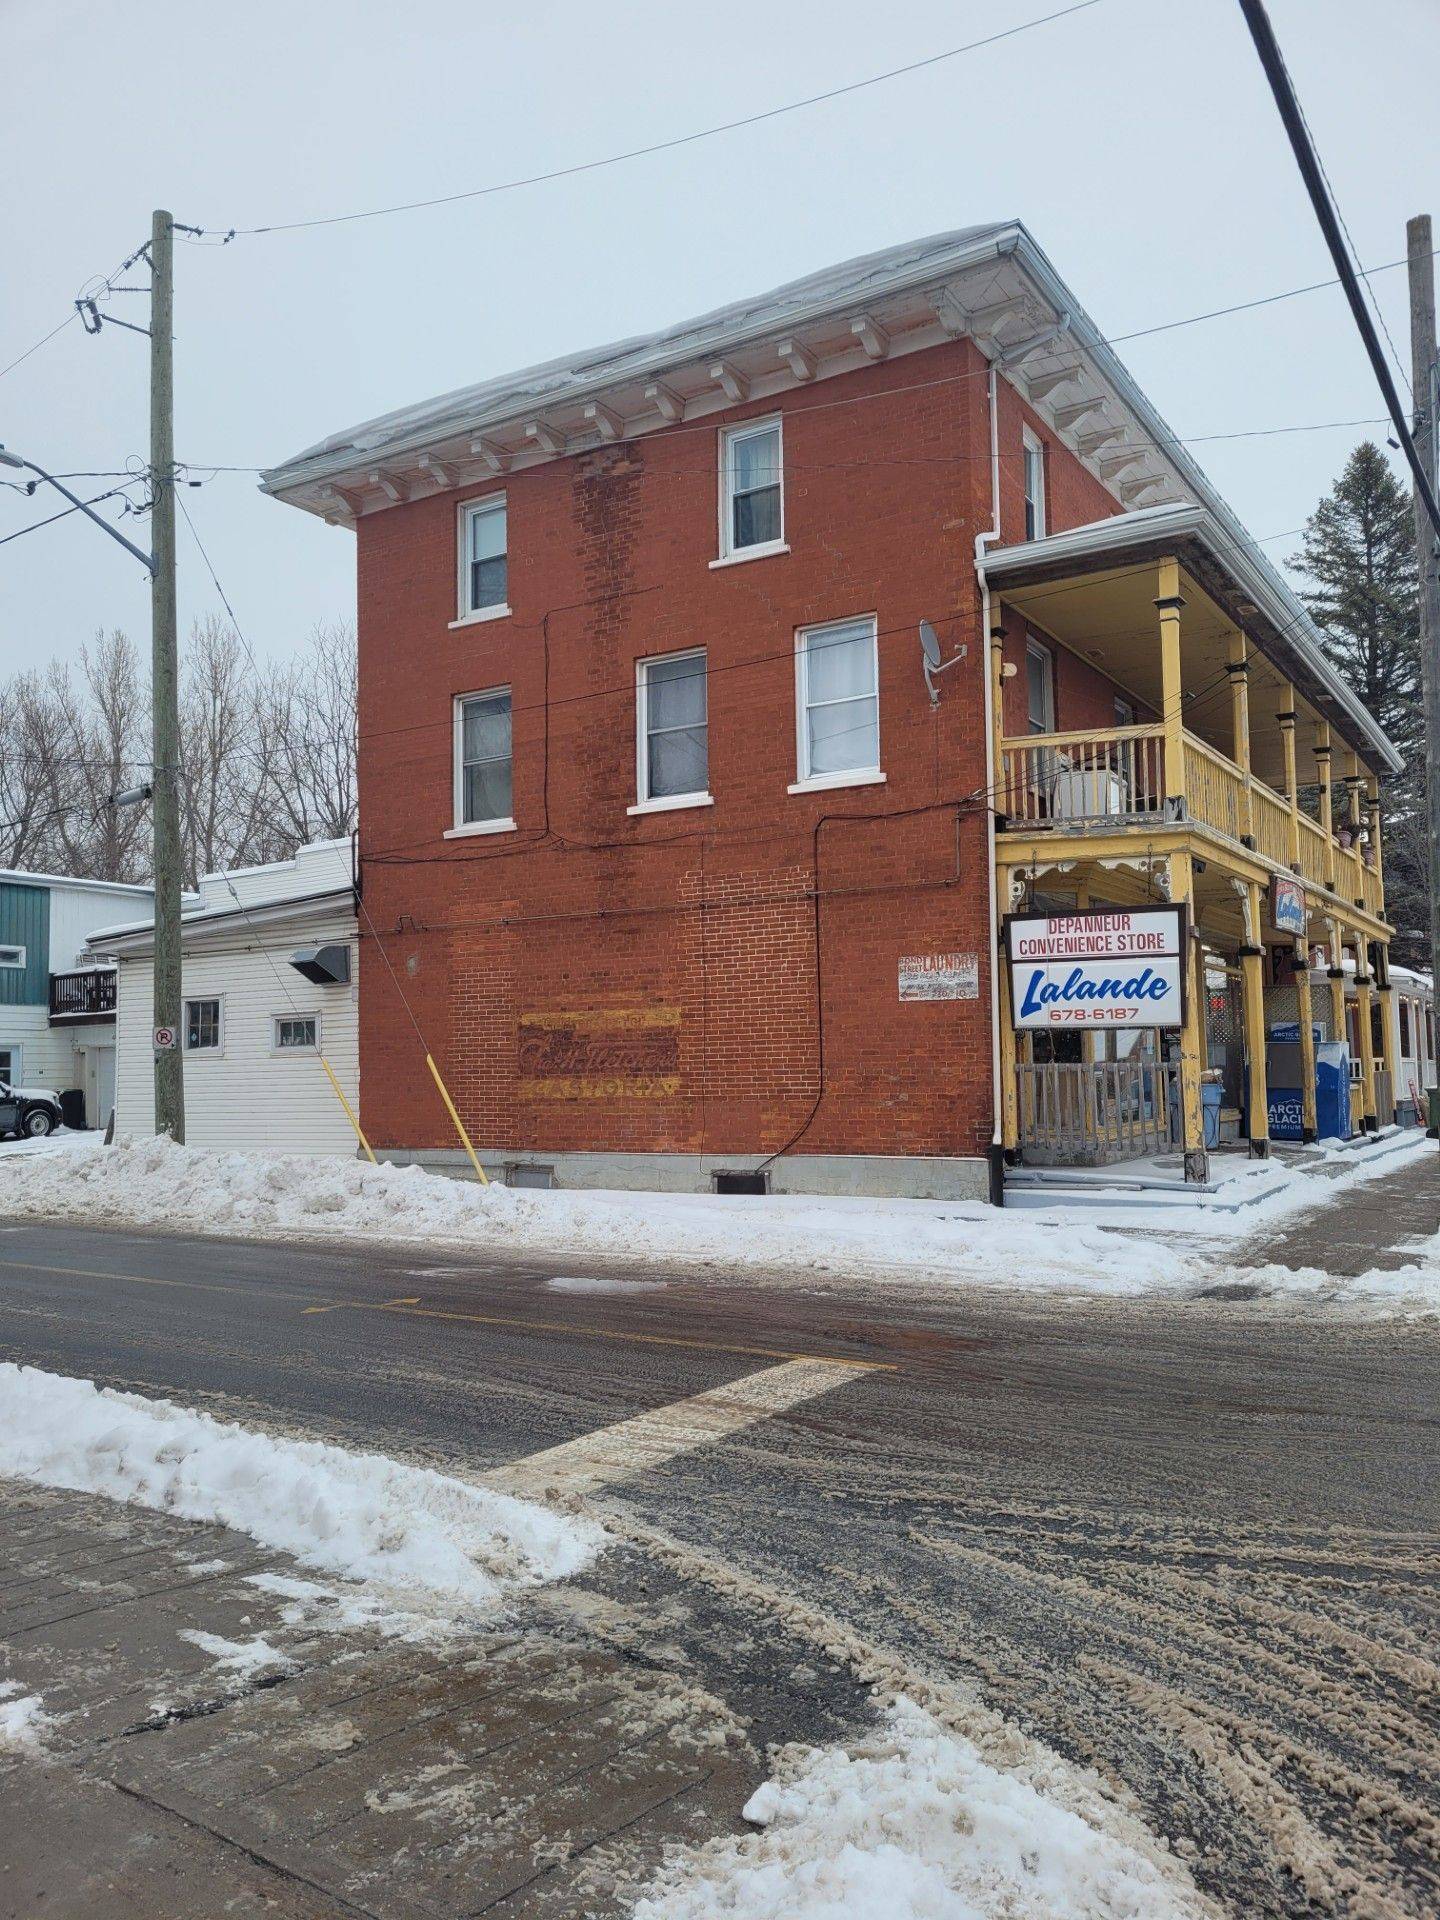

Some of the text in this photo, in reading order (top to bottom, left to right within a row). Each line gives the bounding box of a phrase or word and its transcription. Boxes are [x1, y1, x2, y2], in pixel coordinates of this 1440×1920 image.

[1049, 914, 1131, 935] DEPANNEUR
[1019, 932, 1165, 956] CONVENIENCE STORE
[923, 953, 976, 971] LAUNDRY
[1020, 967, 1173, 1019] Lalande
[1050, 1007, 1139, 1021] 678-6187
